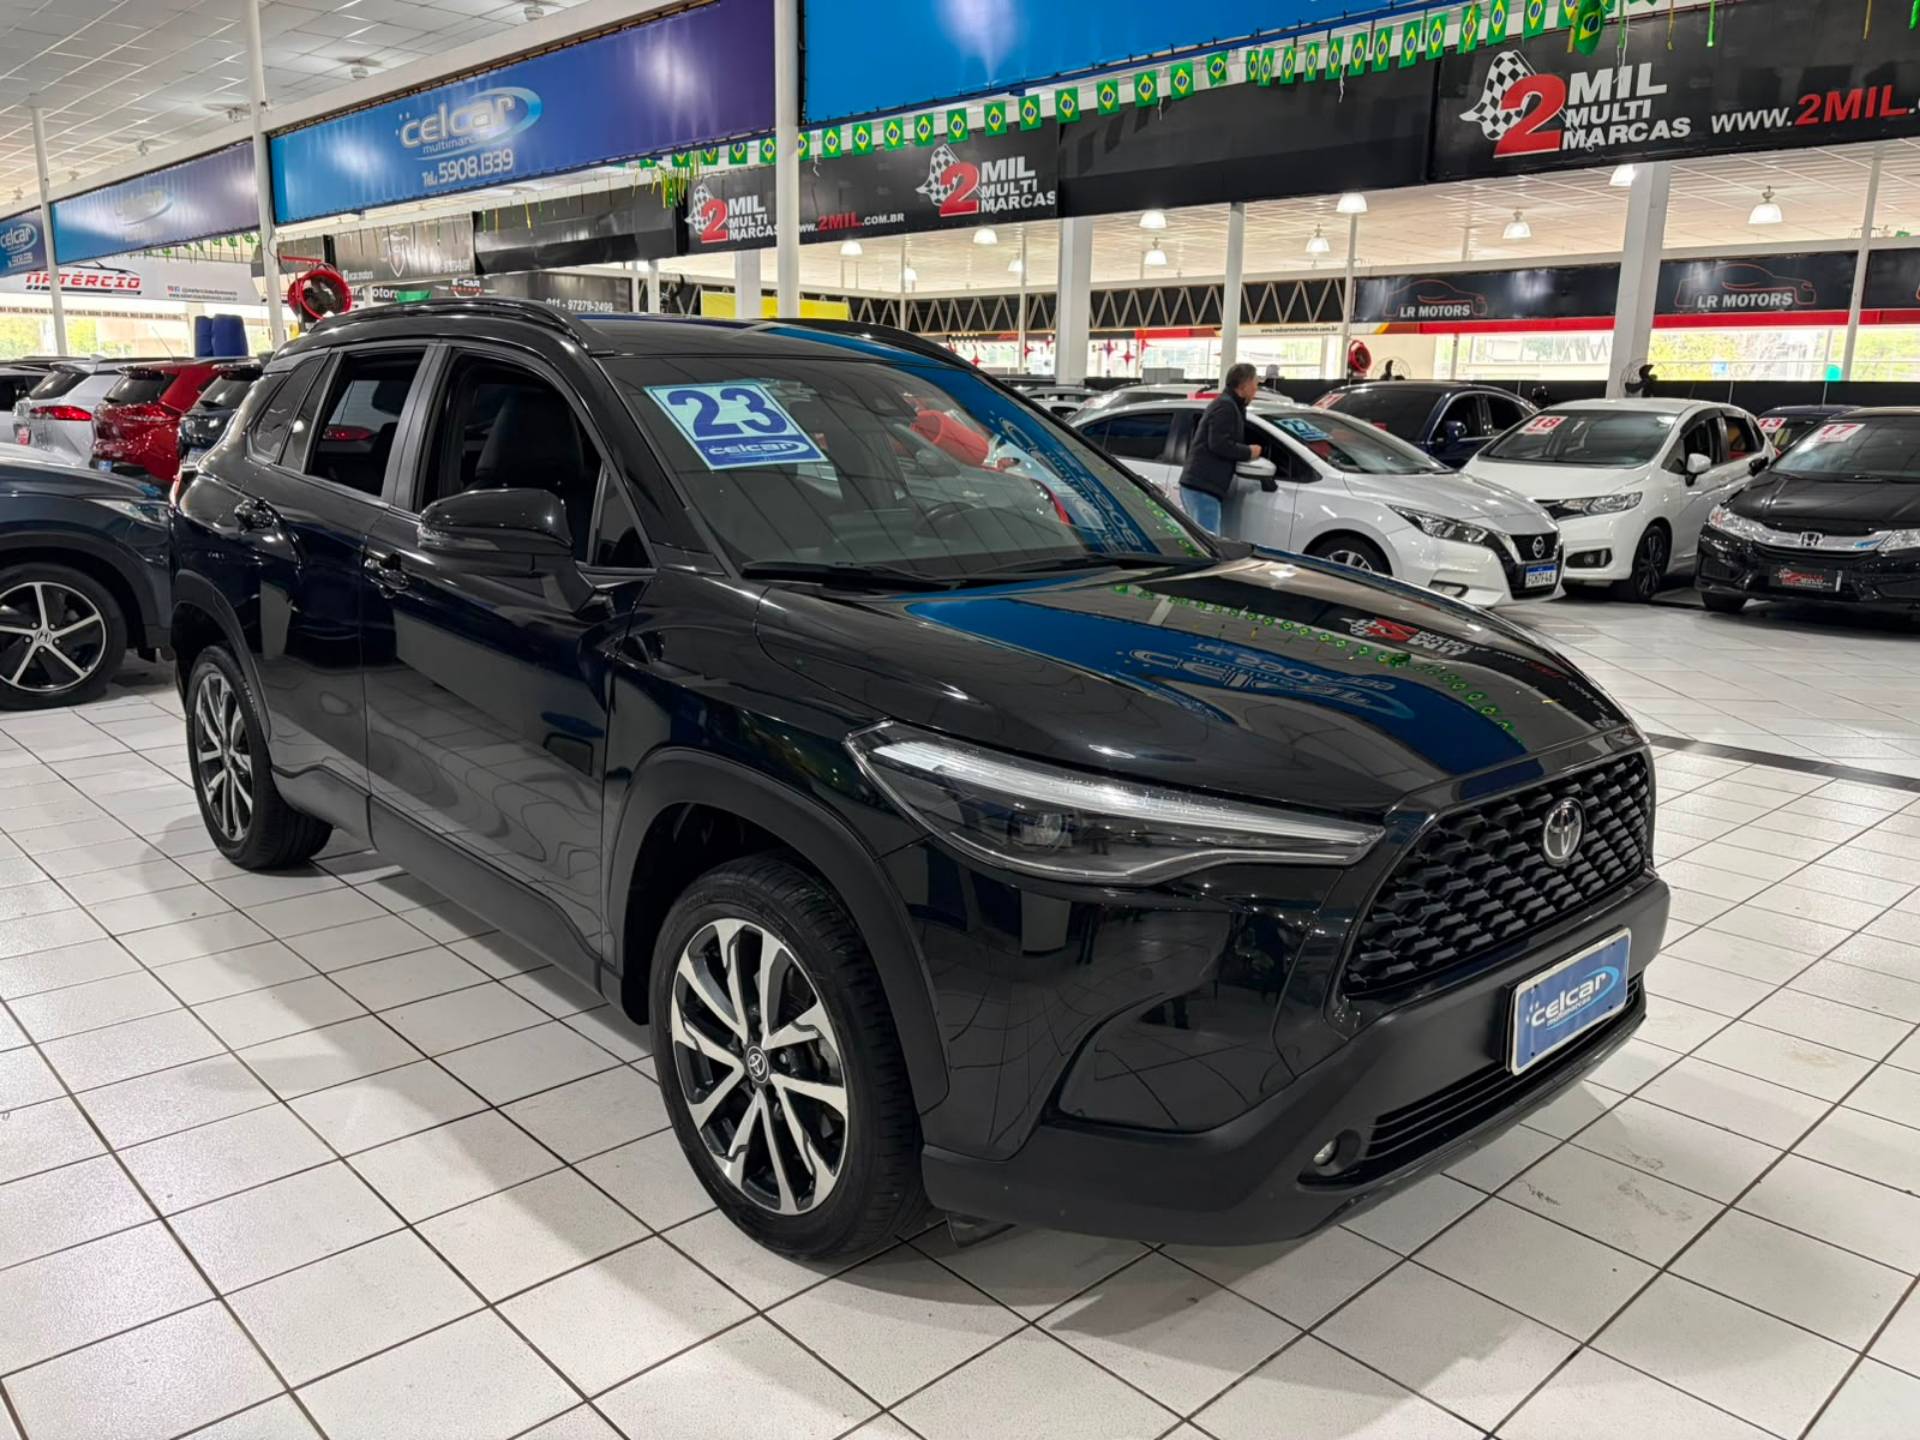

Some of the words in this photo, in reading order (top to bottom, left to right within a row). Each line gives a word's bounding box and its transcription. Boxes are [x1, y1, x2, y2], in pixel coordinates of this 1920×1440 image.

[1568, 62, 1668, 106] MIL
[402, 96, 515, 147] celcar
[1493, 73, 1567, 158] 2
[1565, 99, 1652, 128] MULTI
[1562, 117, 1692, 150] MARCAS
[438, 148, 515, 184] 5908.1339
[981, 156, 1036, 183] MIL
[939, 162, 980, 217] 2
[981, 179, 1038, 198] MULTI
[981, 190, 1057, 214] MARCAS
[701, 198, 728, 244] 2
[728, 195, 766, 217] MIL
[728, 214, 768, 229] MULTI
[1400, 306, 1416, 318] LR
[1418, 304, 1472, 318] MOTORS
[1697, 295, 1718, 309] LR
[1722, 292, 1794, 308] MOTORS
[666, 387, 788, 437] 23
[1531, 973, 1607, 1028] celcar
